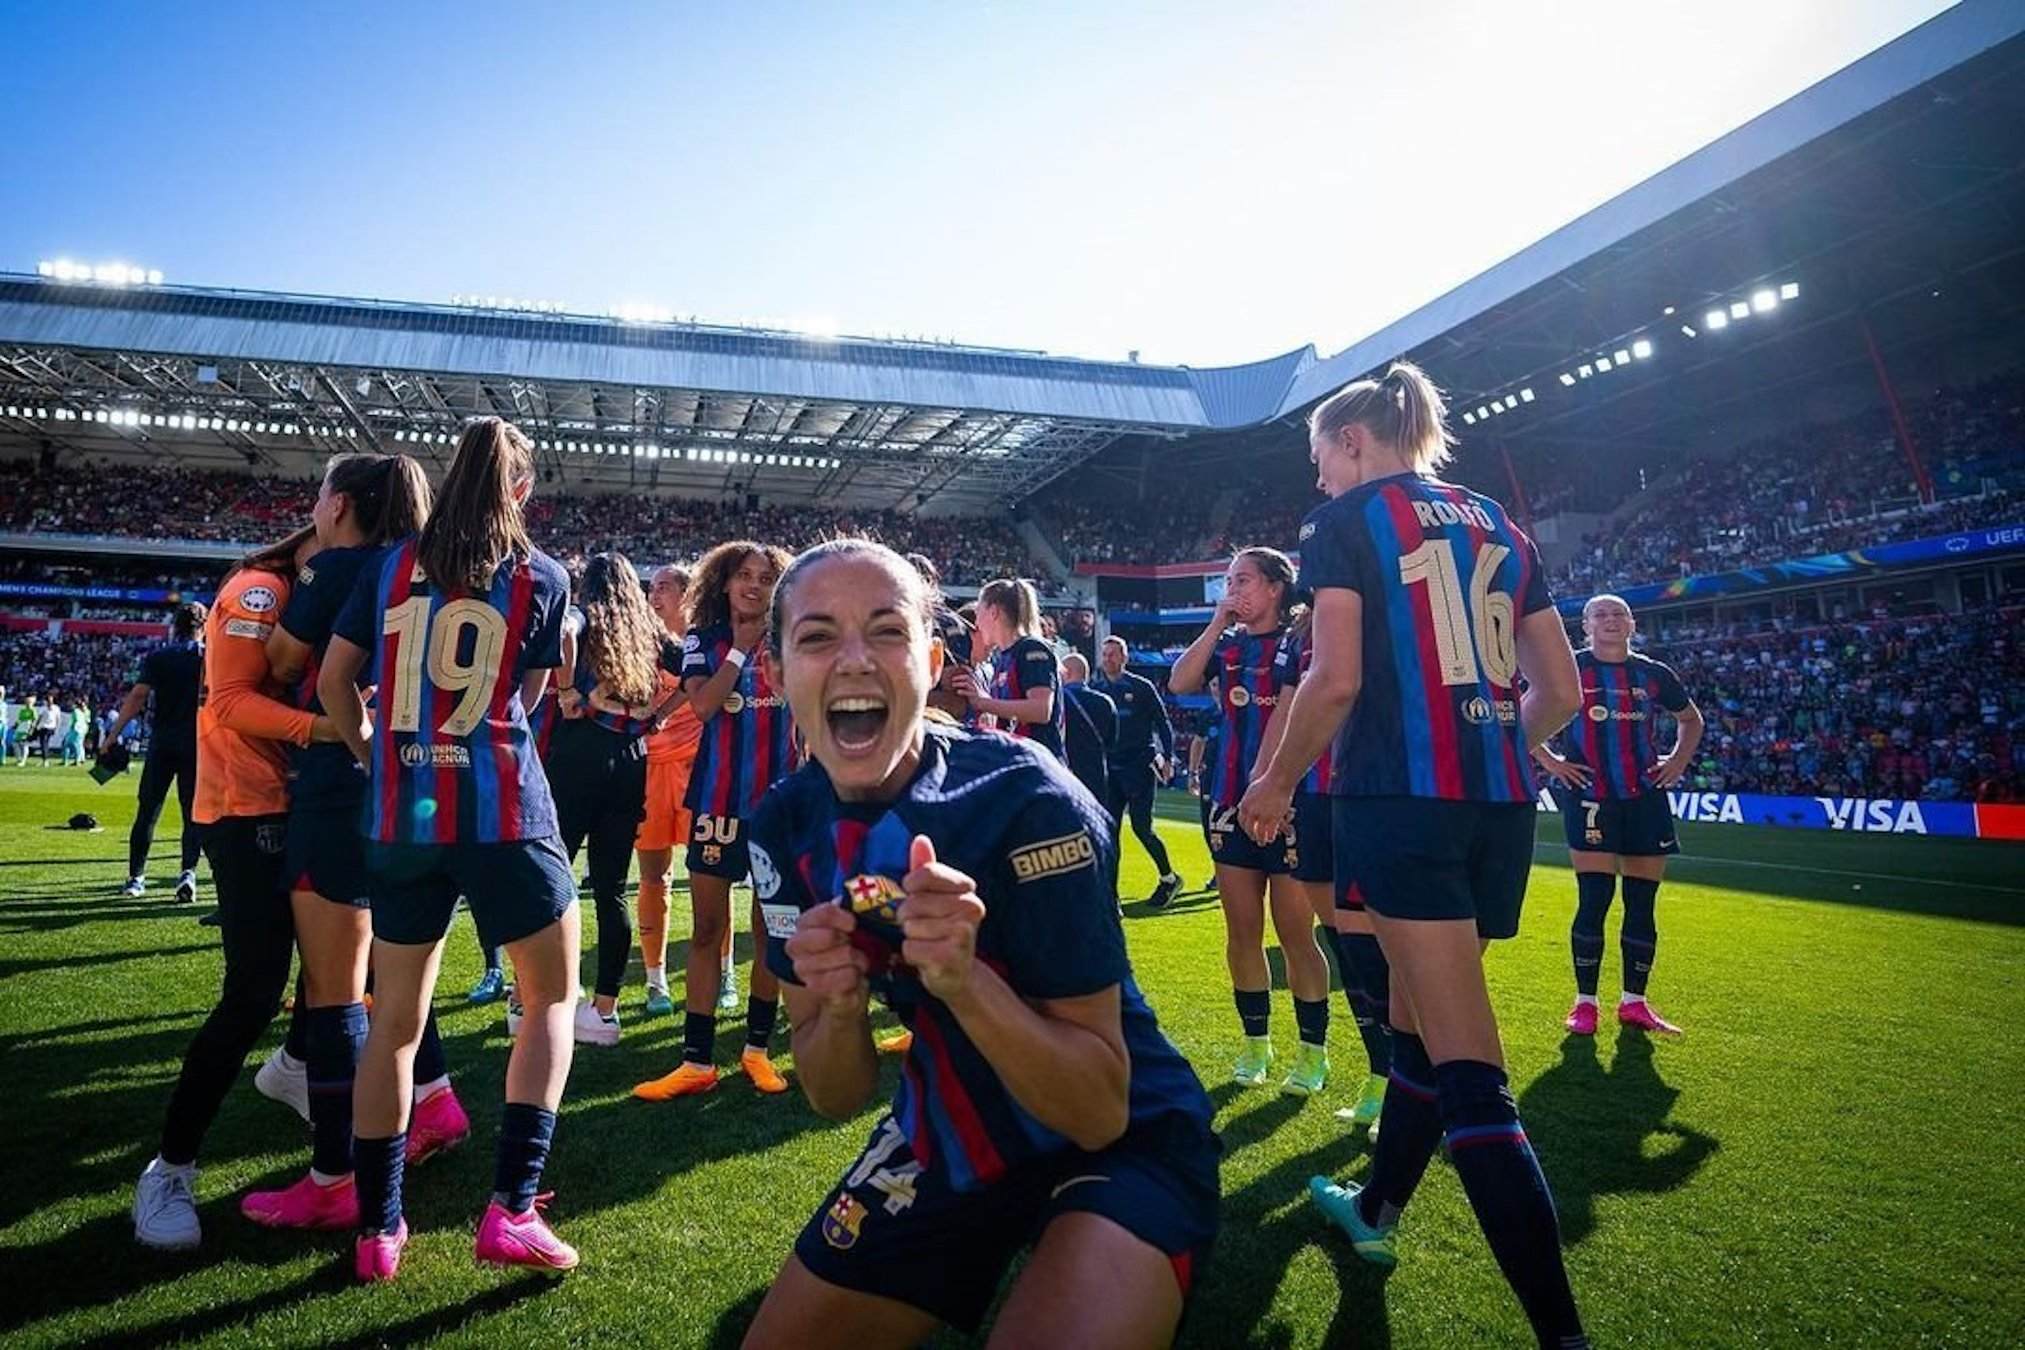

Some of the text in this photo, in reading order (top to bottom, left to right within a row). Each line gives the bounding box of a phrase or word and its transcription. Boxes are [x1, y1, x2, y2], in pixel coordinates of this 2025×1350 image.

[86, 587, 120, 598] LEAGUE
[1398, 539, 1516, 689] 16
[383, 596, 509, 736] 19
[1581, 800, 1600, 828] 7
[1667, 791, 1744, 824] VISA
[1814, 797, 1927, 834] VISA
[1012, 835, 1094, 878] BIMBO
